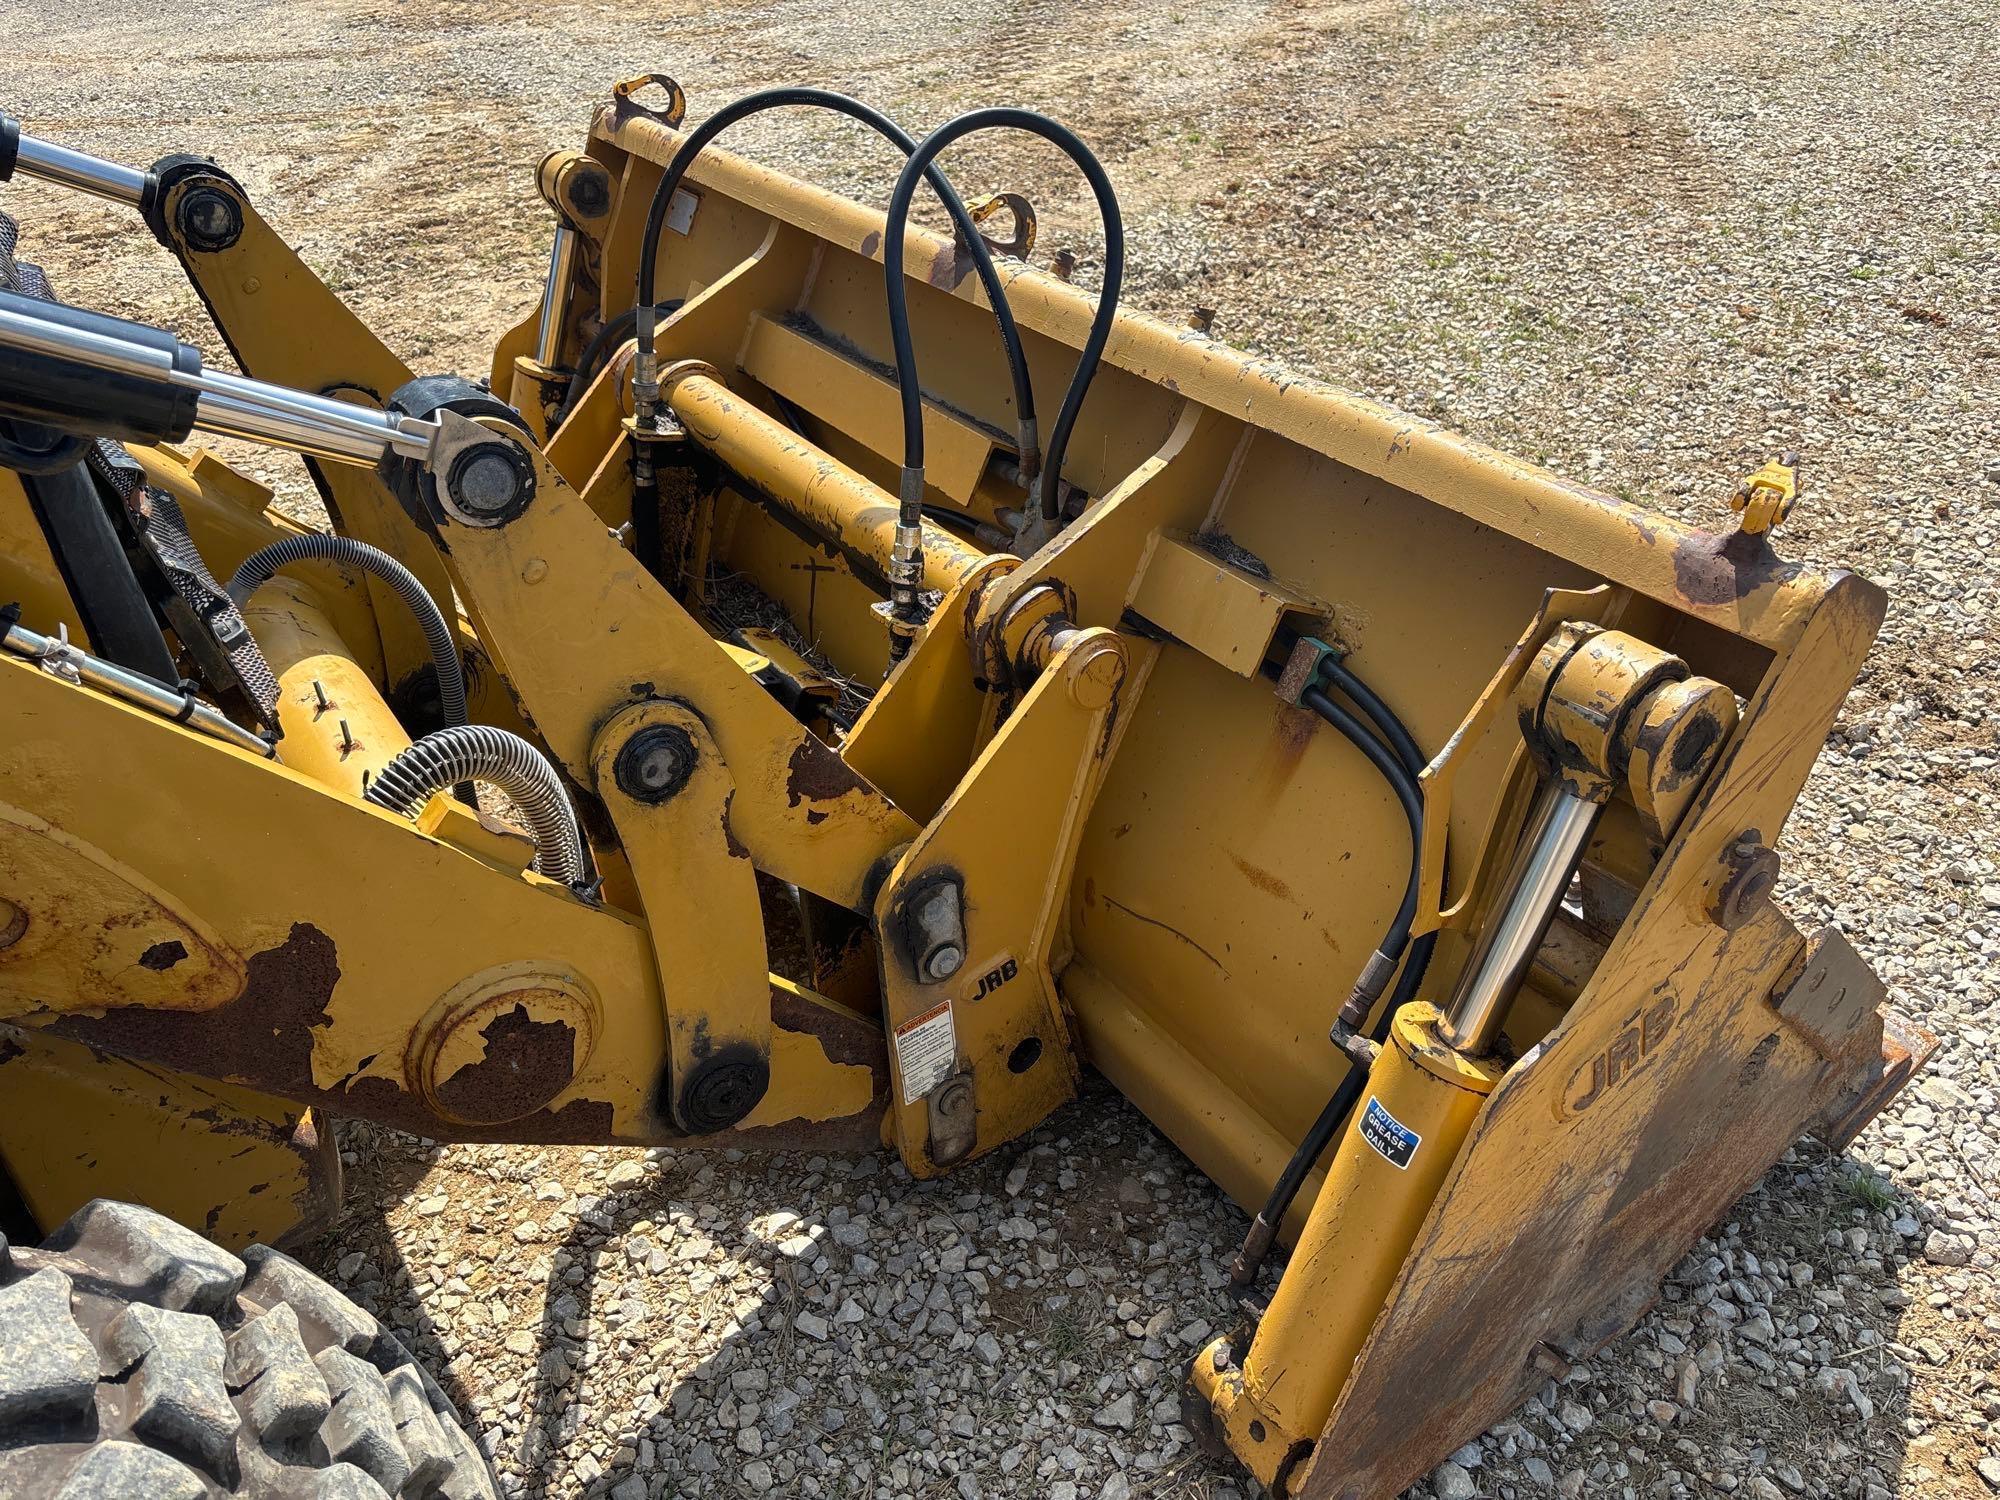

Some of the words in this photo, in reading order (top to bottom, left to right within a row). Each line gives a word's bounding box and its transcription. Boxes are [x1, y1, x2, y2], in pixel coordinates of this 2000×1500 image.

[972, 959, 1018, 1001] JRB
[907, 1005, 947, 1030] ADVERTENCIA
[1573, 996, 1675, 1111] JRB
[1368, 1113, 1407, 1151] GREASE
[1373, 1106, 1409, 1139] NOTICE
[1366, 1128, 1395, 1157] DAILY
